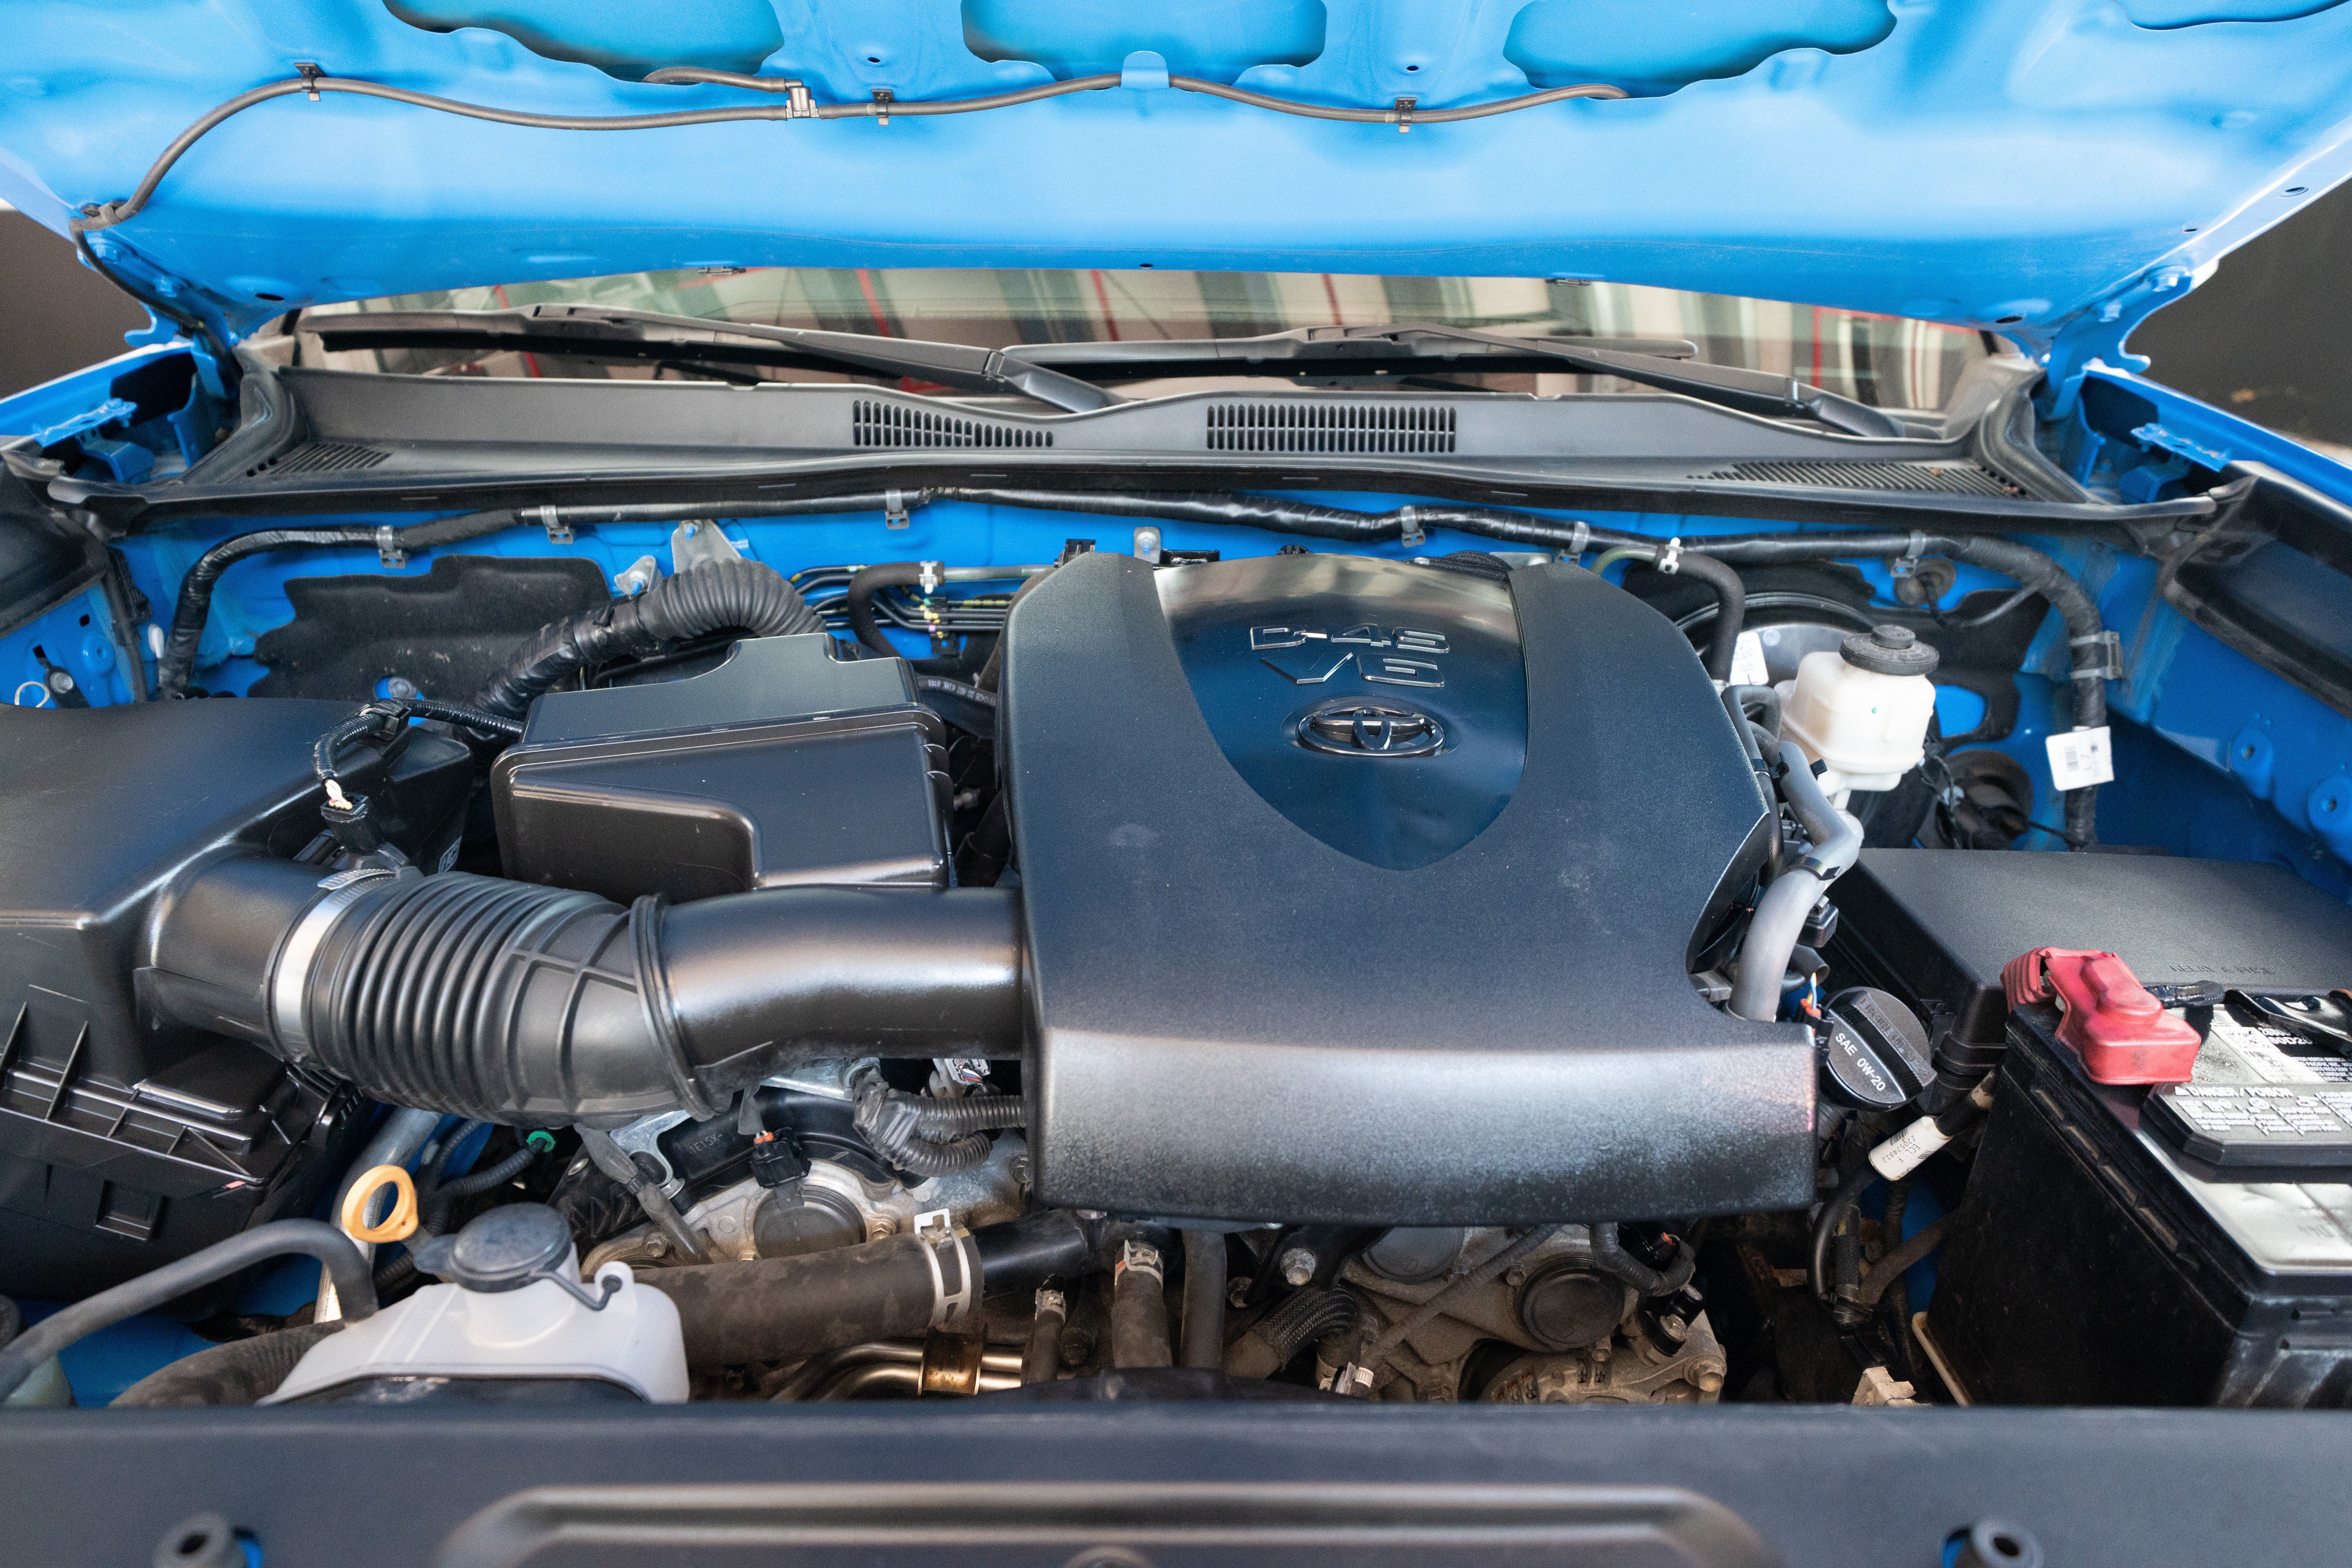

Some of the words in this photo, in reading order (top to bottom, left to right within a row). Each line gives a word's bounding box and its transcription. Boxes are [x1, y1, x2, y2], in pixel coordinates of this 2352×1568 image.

[1260, 652, 1445, 688] V6
[1835, 1032, 1858, 1057] SAE
[1856, 1058, 1886, 1091] 0W-20
[1882, 1135, 1916, 1163] Z20574812
